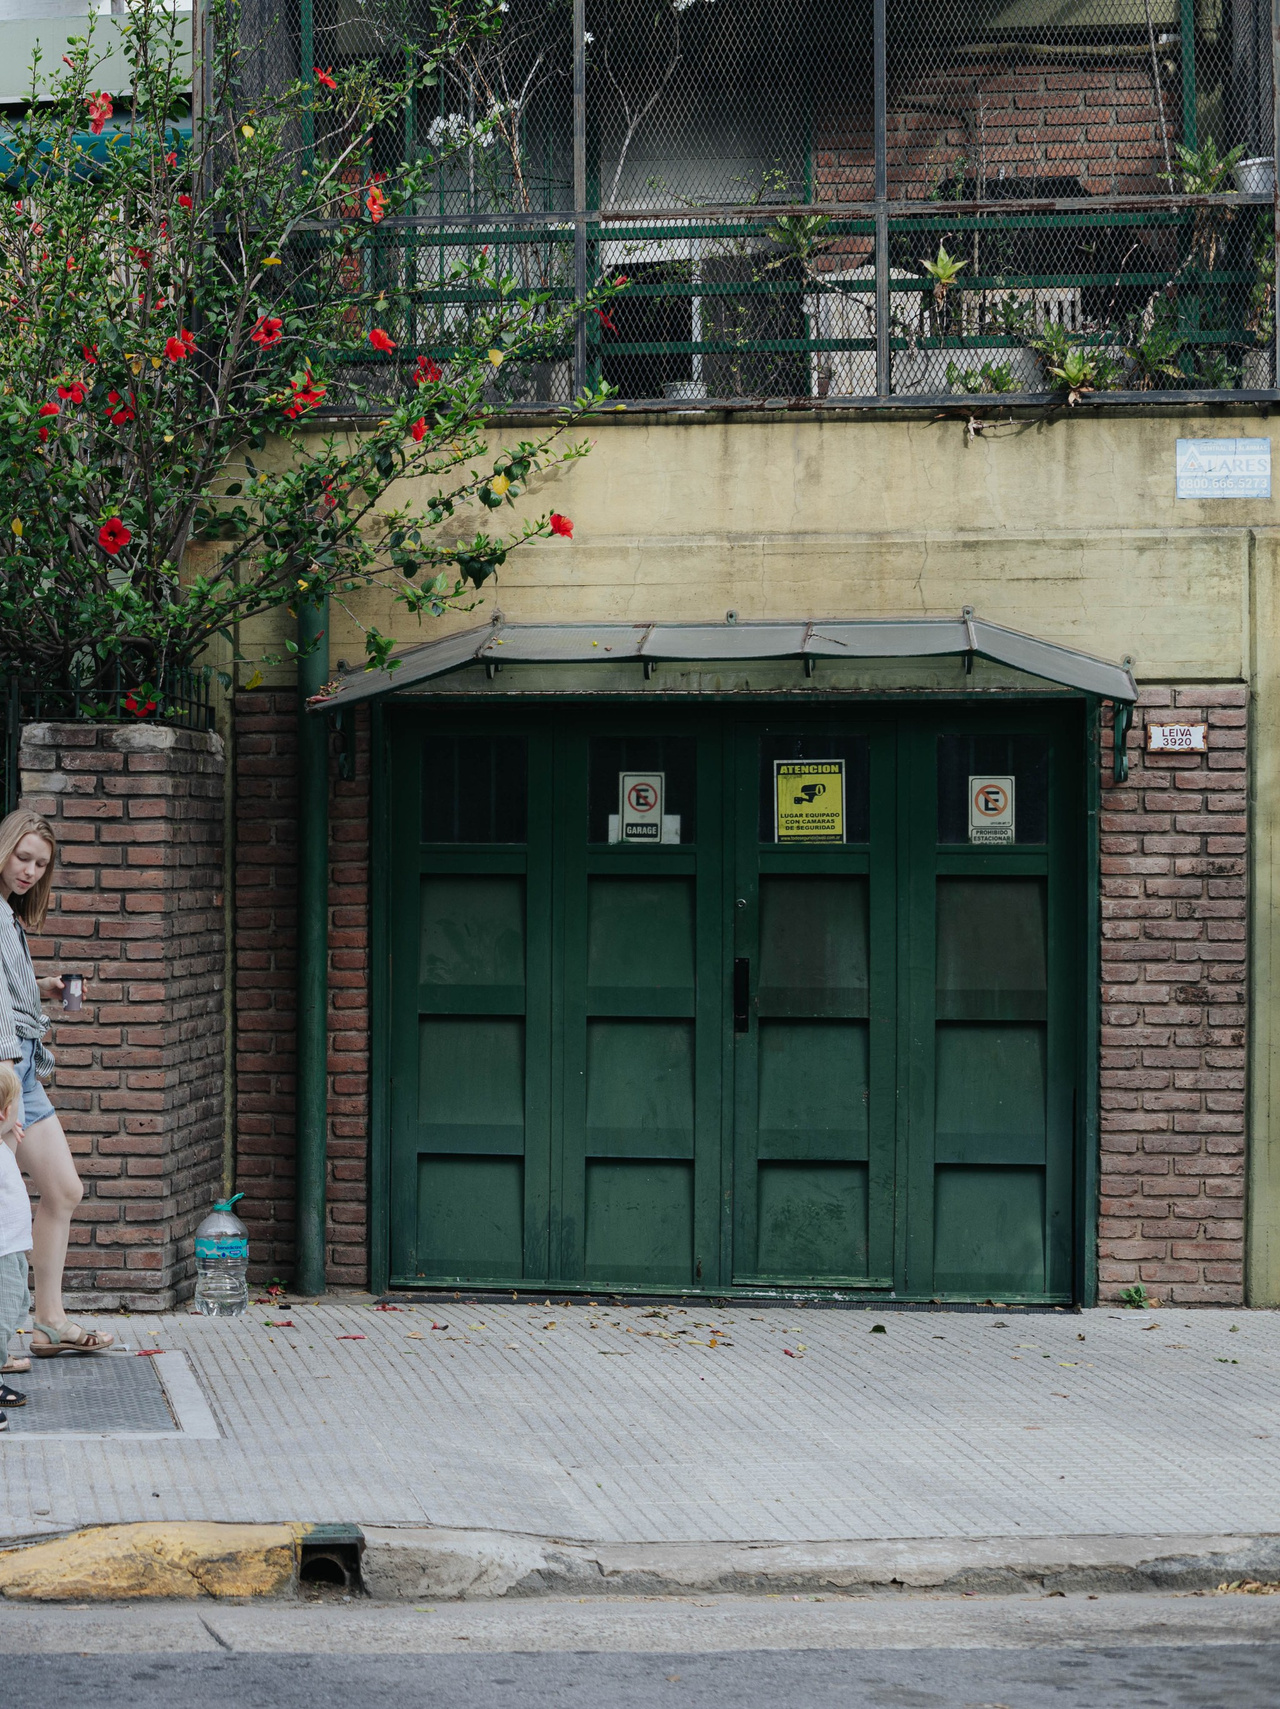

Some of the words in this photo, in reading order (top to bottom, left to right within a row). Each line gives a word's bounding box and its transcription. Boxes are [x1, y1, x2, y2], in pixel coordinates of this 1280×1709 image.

[1179, 478, 1268, 488] 0800.666.5273
[1162, 728, 1192, 737] LEIVA
[1162, 737, 1192, 746] 3920
[780, 764, 839, 774] ATENCION
[626, 826, 657, 835] GARAGE
